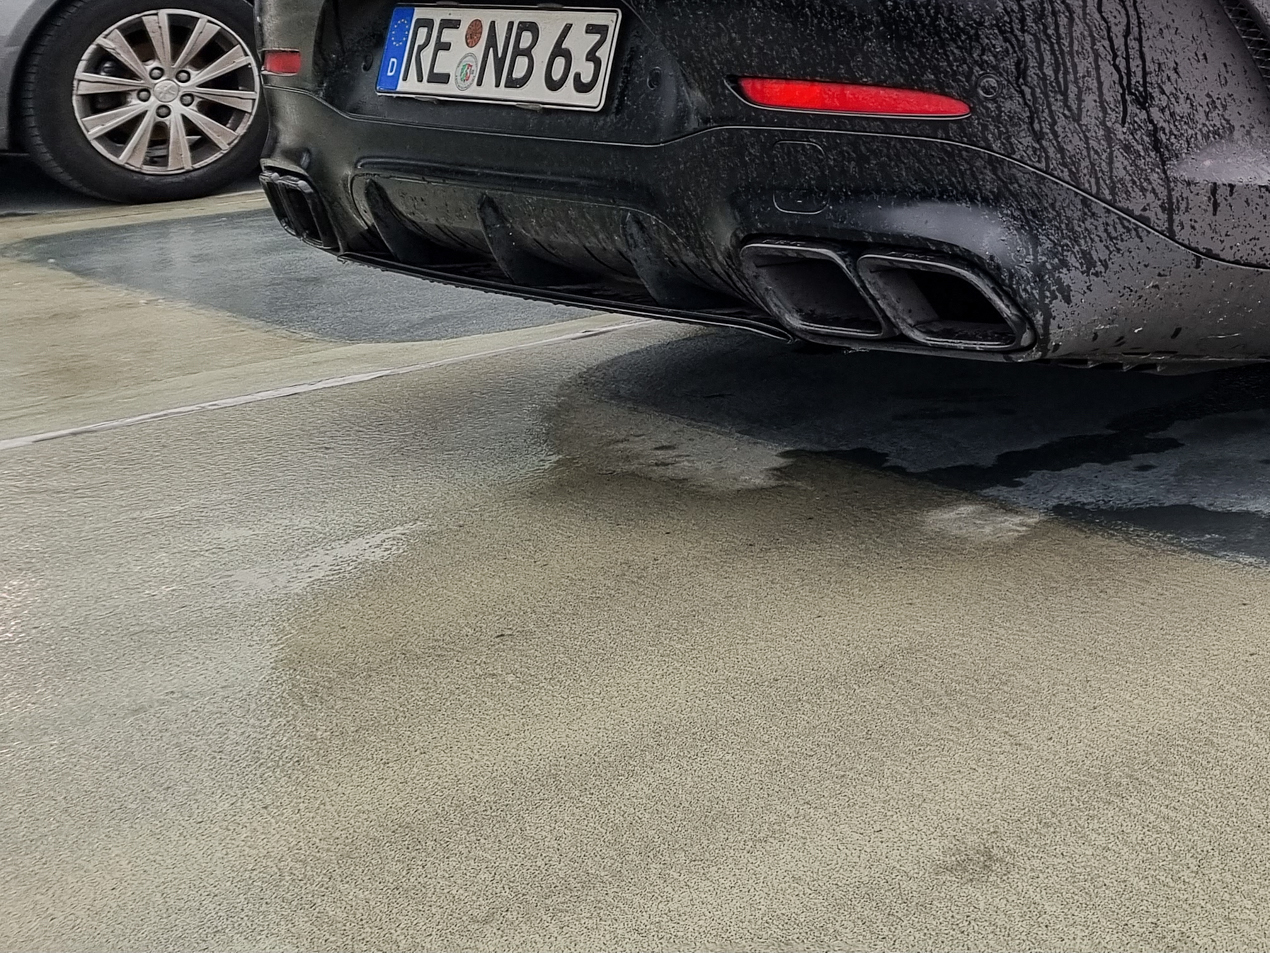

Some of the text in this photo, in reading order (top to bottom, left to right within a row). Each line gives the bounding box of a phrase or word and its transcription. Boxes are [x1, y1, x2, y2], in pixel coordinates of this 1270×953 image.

[387, 57, 398, 77] D
[401, 17, 609, 94] RE NB 63
